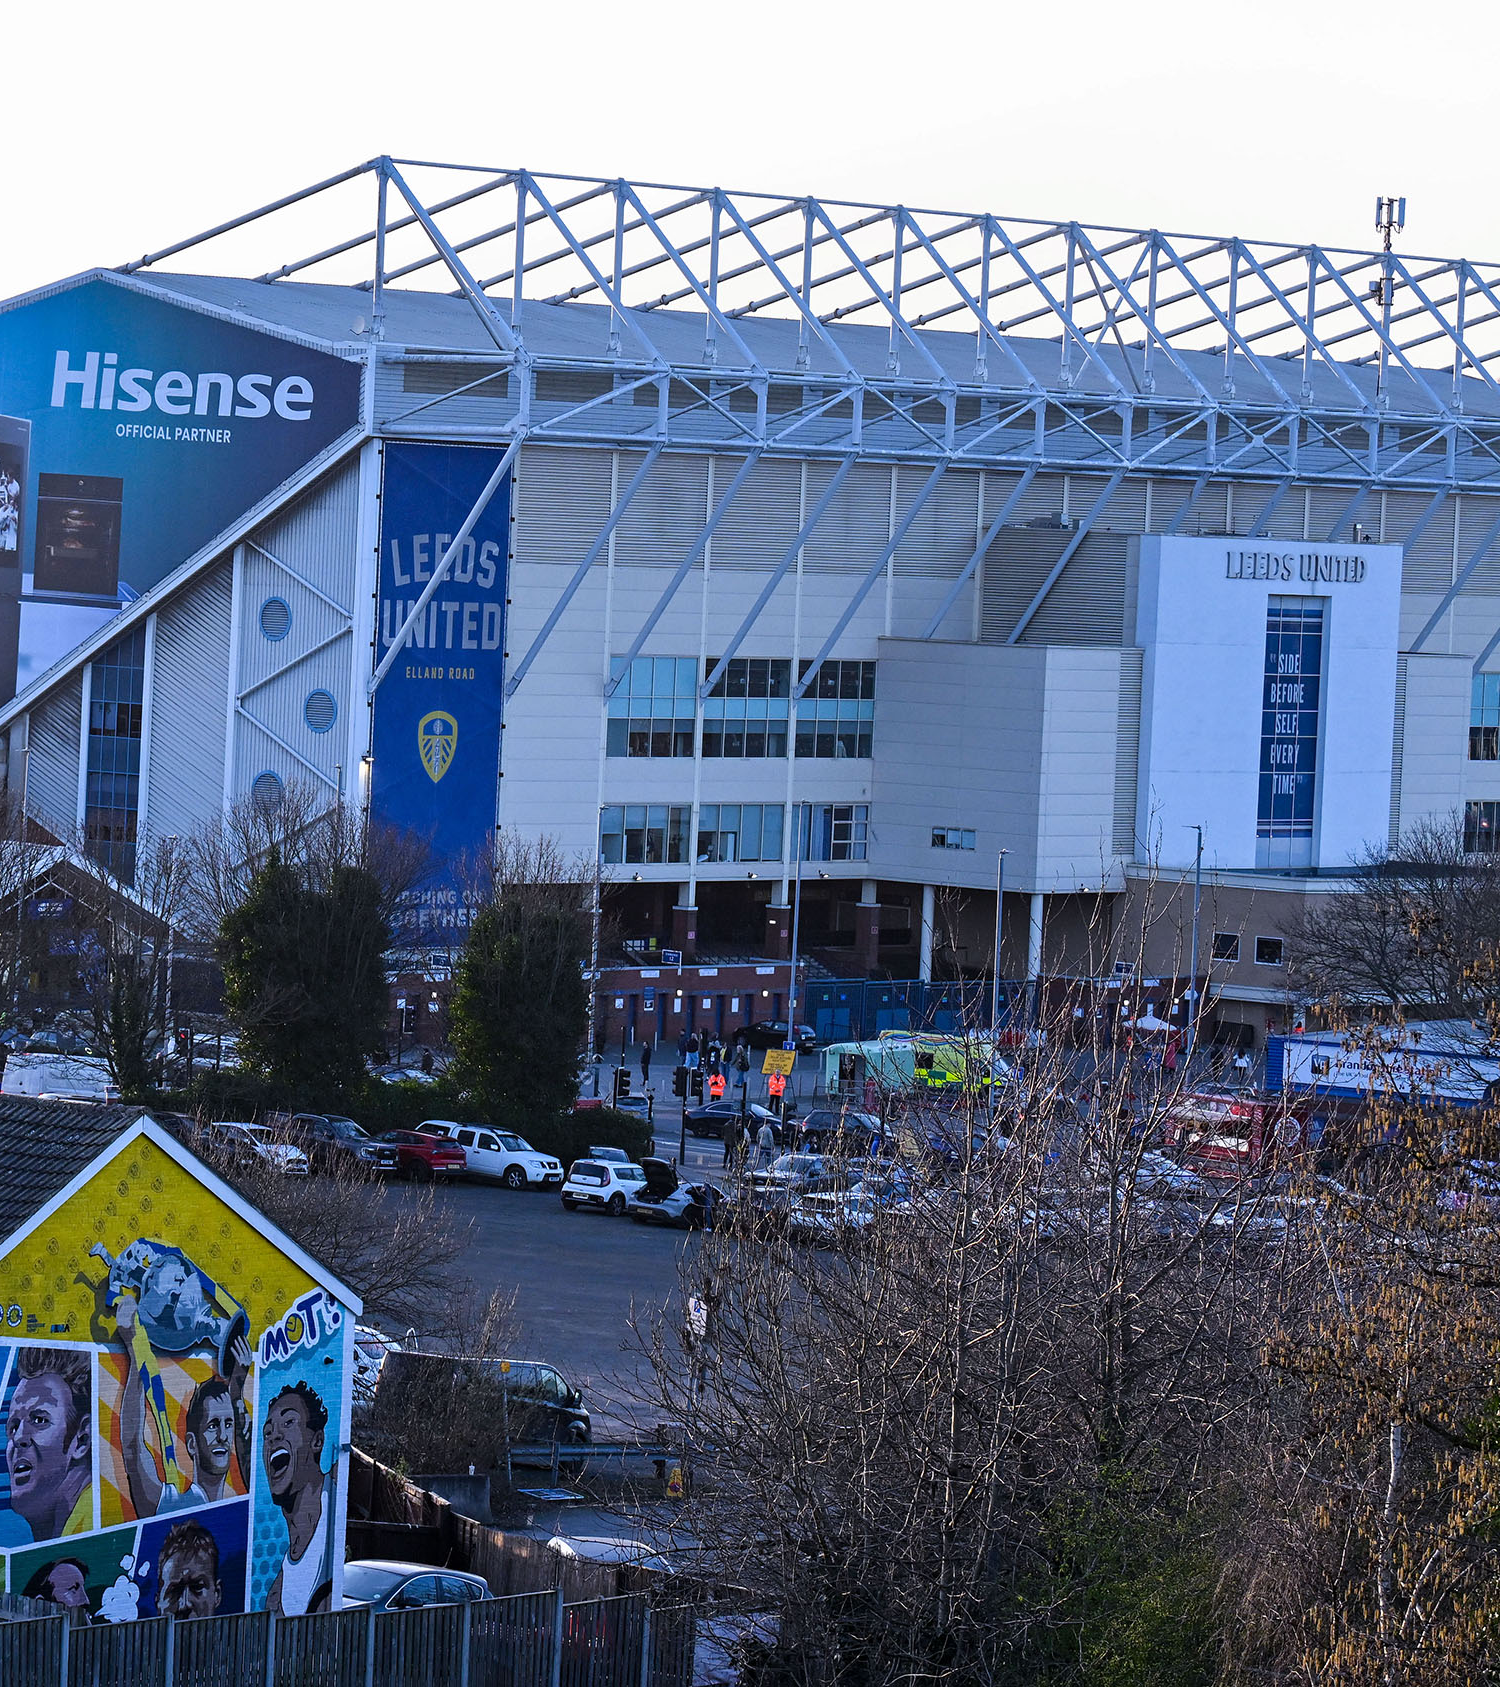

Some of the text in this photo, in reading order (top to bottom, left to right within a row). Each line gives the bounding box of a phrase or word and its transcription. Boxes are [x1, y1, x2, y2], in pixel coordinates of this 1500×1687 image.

[51, 350, 314, 421] Hisense
[115, 423, 231, 444] OFFICIAL PARTNER
[391, 533, 500, 589] LEEDS
[1225, 551, 1368, 584] LEEDS UNITED
[382, 599, 502, 650] UNITED
[405, 666, 475, 680] ELLAND ROAD
[1270, 683, 1304, 703] BEFORE
[1270, 744, 1300, 764] EVERY
